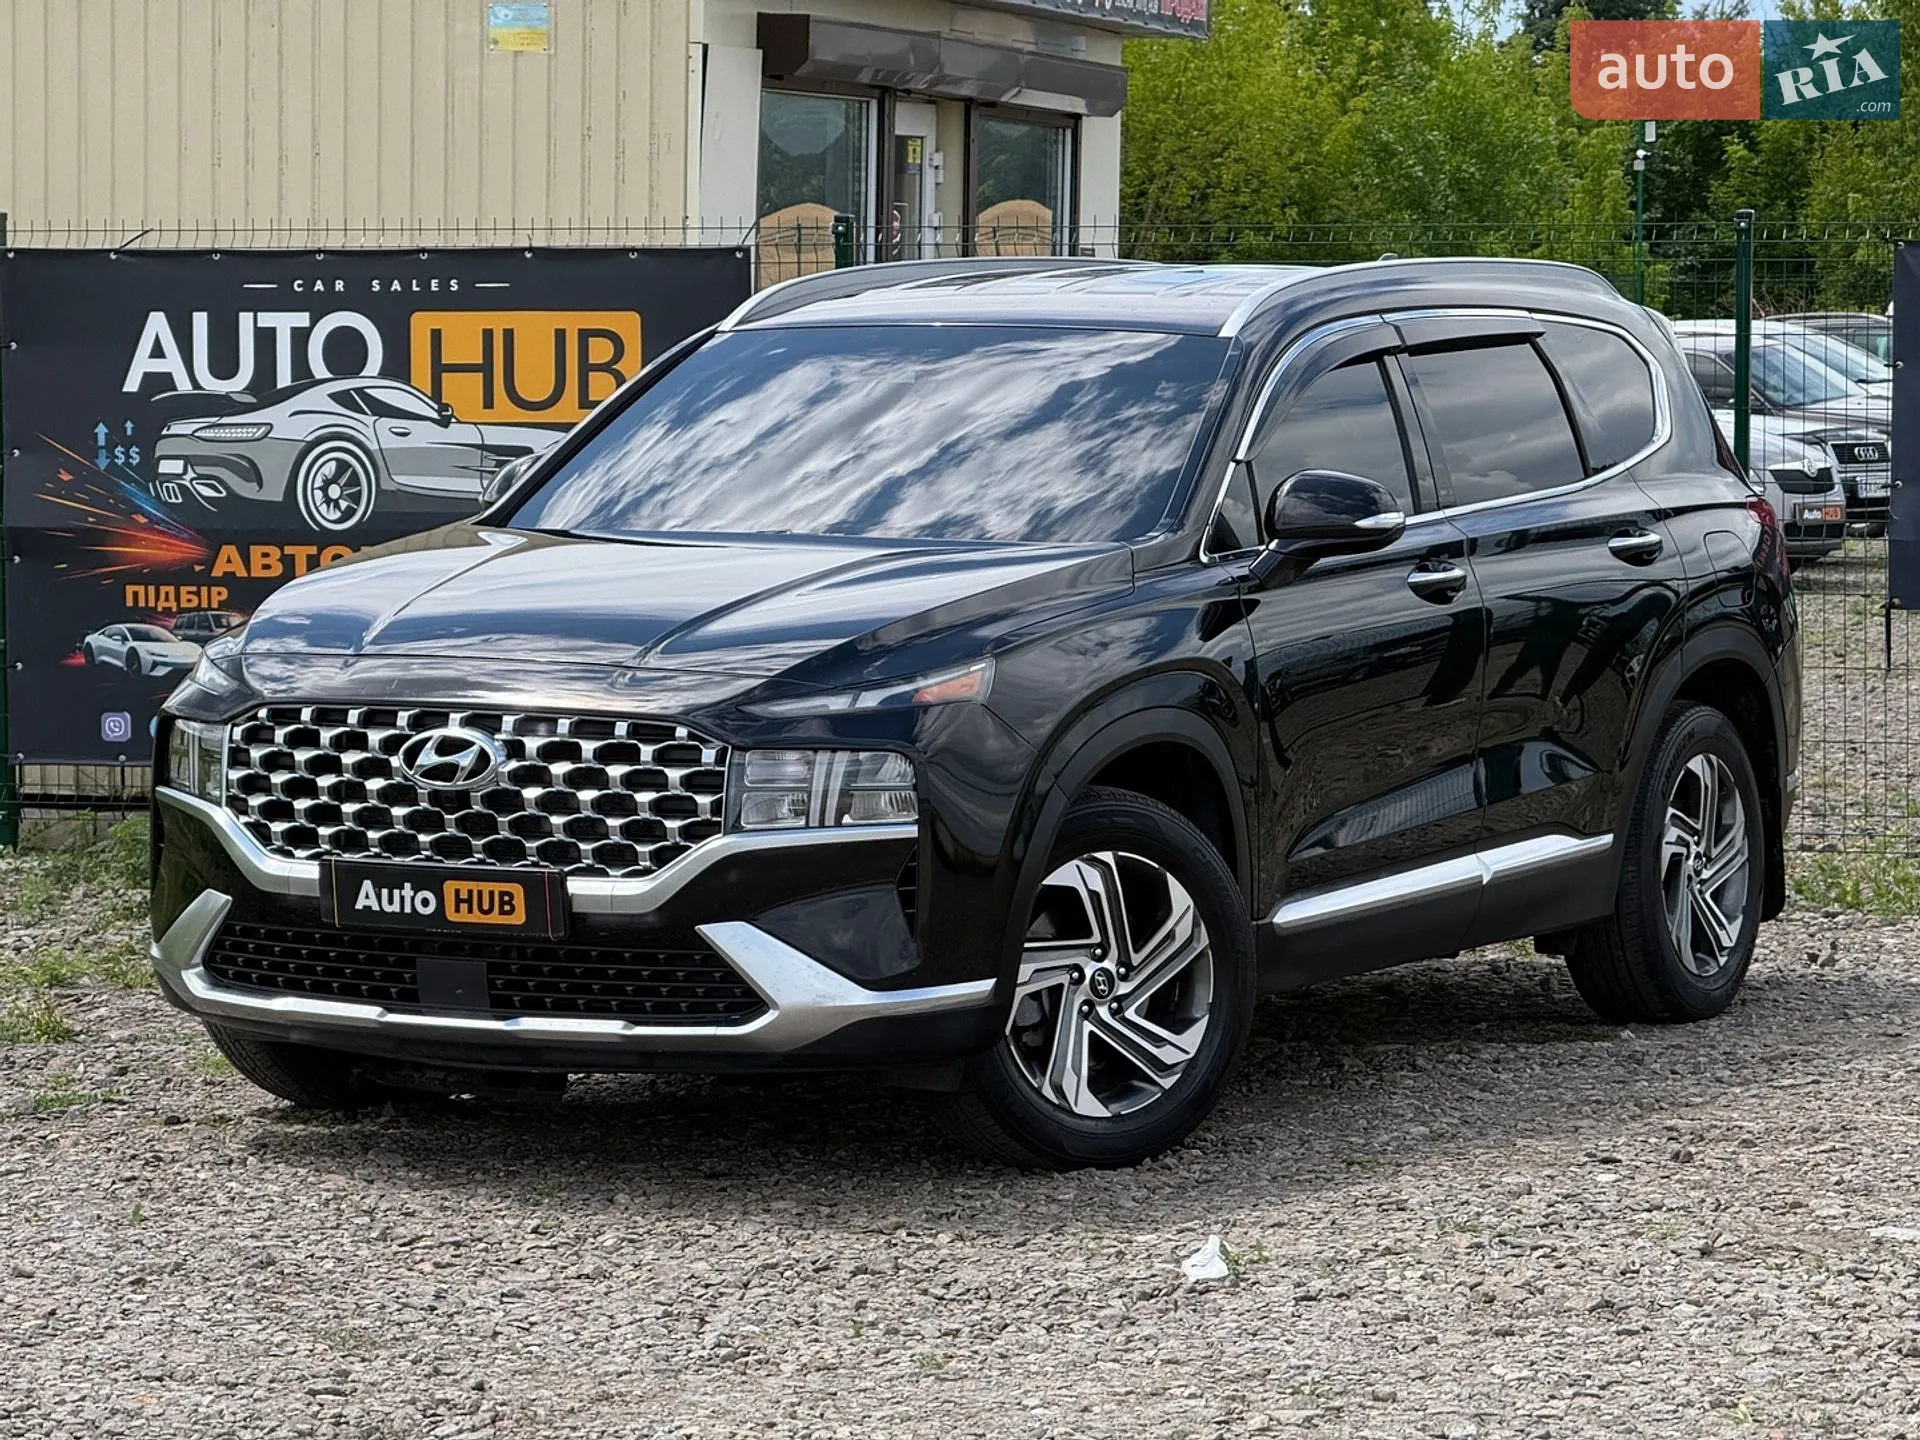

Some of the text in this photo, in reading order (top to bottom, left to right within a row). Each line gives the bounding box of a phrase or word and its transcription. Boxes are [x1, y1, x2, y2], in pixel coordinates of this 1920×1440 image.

[293, 278, 462, 292] CAR SALES
[122, 310, 627, 412] AUTO HUB
[1803, 508, 1822, 519] Auto
[210, 544, 374, 578] АВТО
[124, 584, 229, 612] ПІДБІР
[354, 879, 516, 917] Auto HUB
